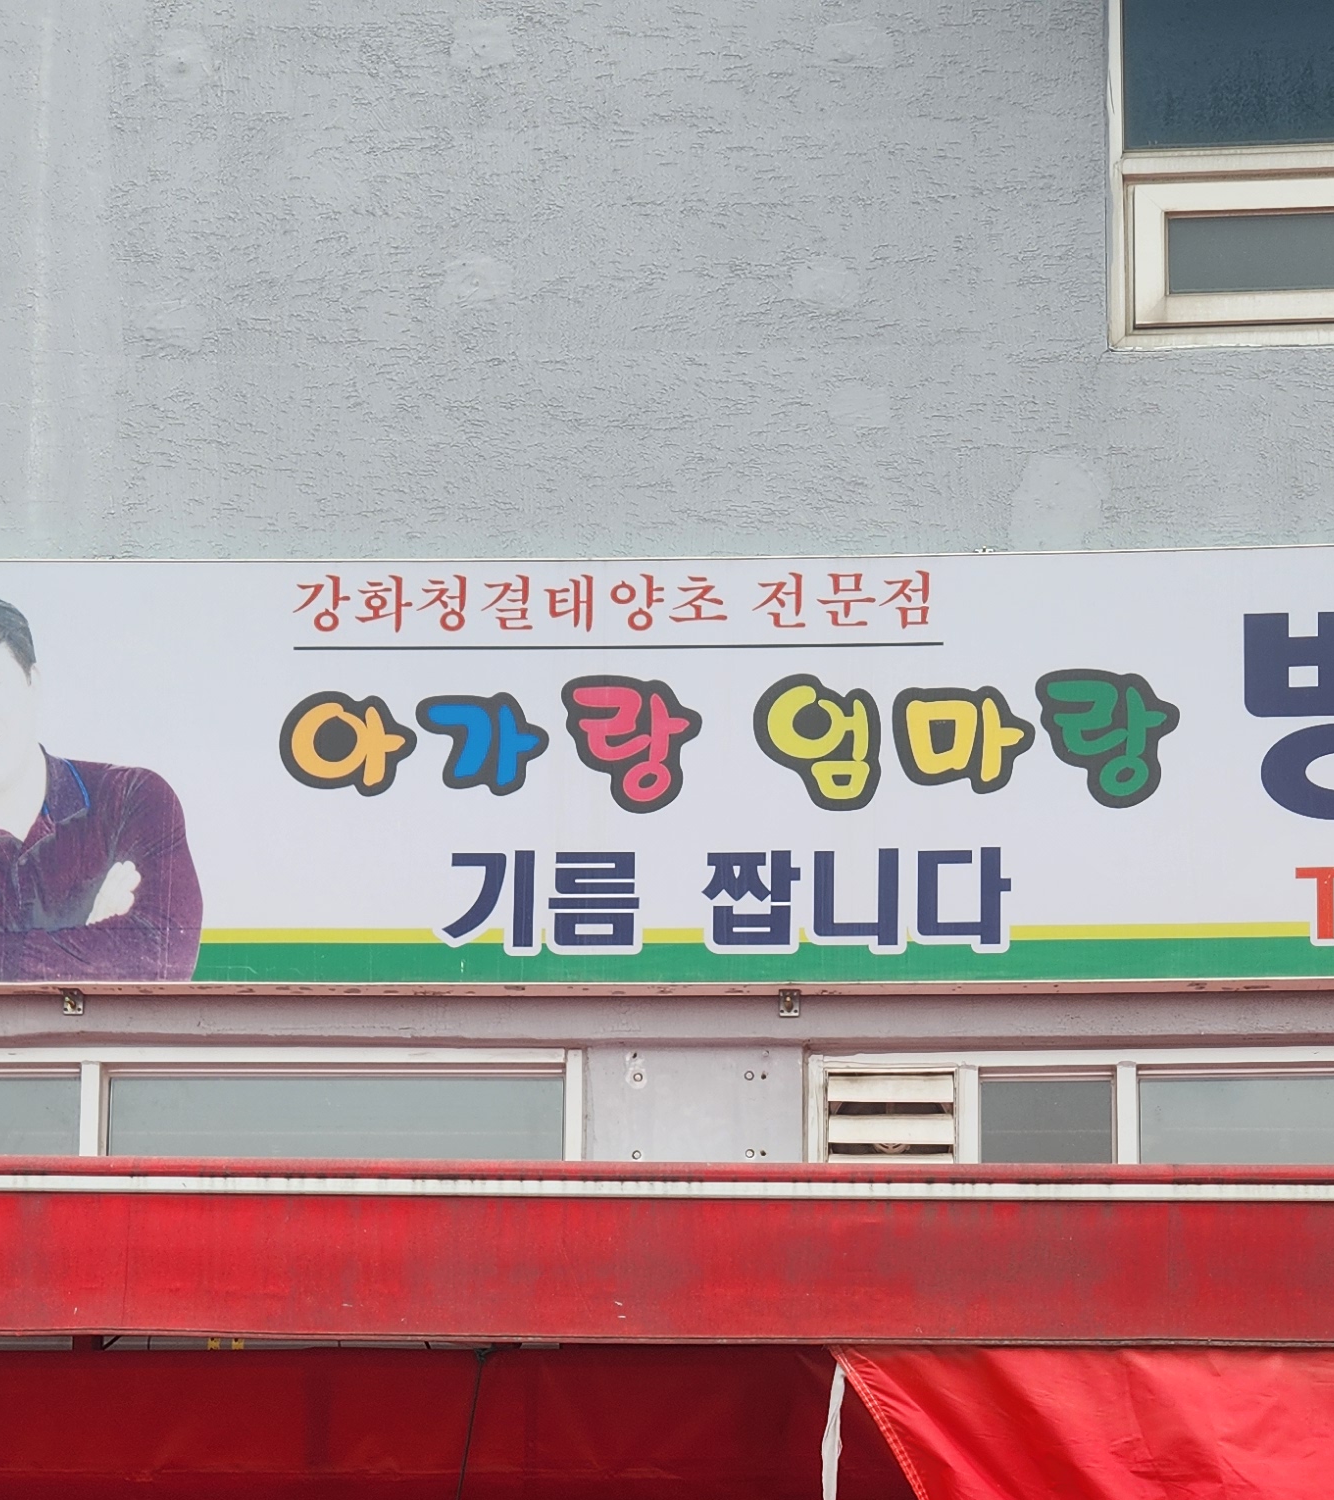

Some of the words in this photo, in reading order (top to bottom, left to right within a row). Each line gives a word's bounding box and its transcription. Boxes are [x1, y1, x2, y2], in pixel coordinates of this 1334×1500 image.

[293, 574, 728, 633] 강화청결태양초
[752, 570, 931, 630] 전문점
[280, 675, 701, 814] 아가랑
[754, 669, 1180, 811] 엄마랑
[441, 850, 640, 949] 기름
[701, 846, 1011, 947] 짭니다
